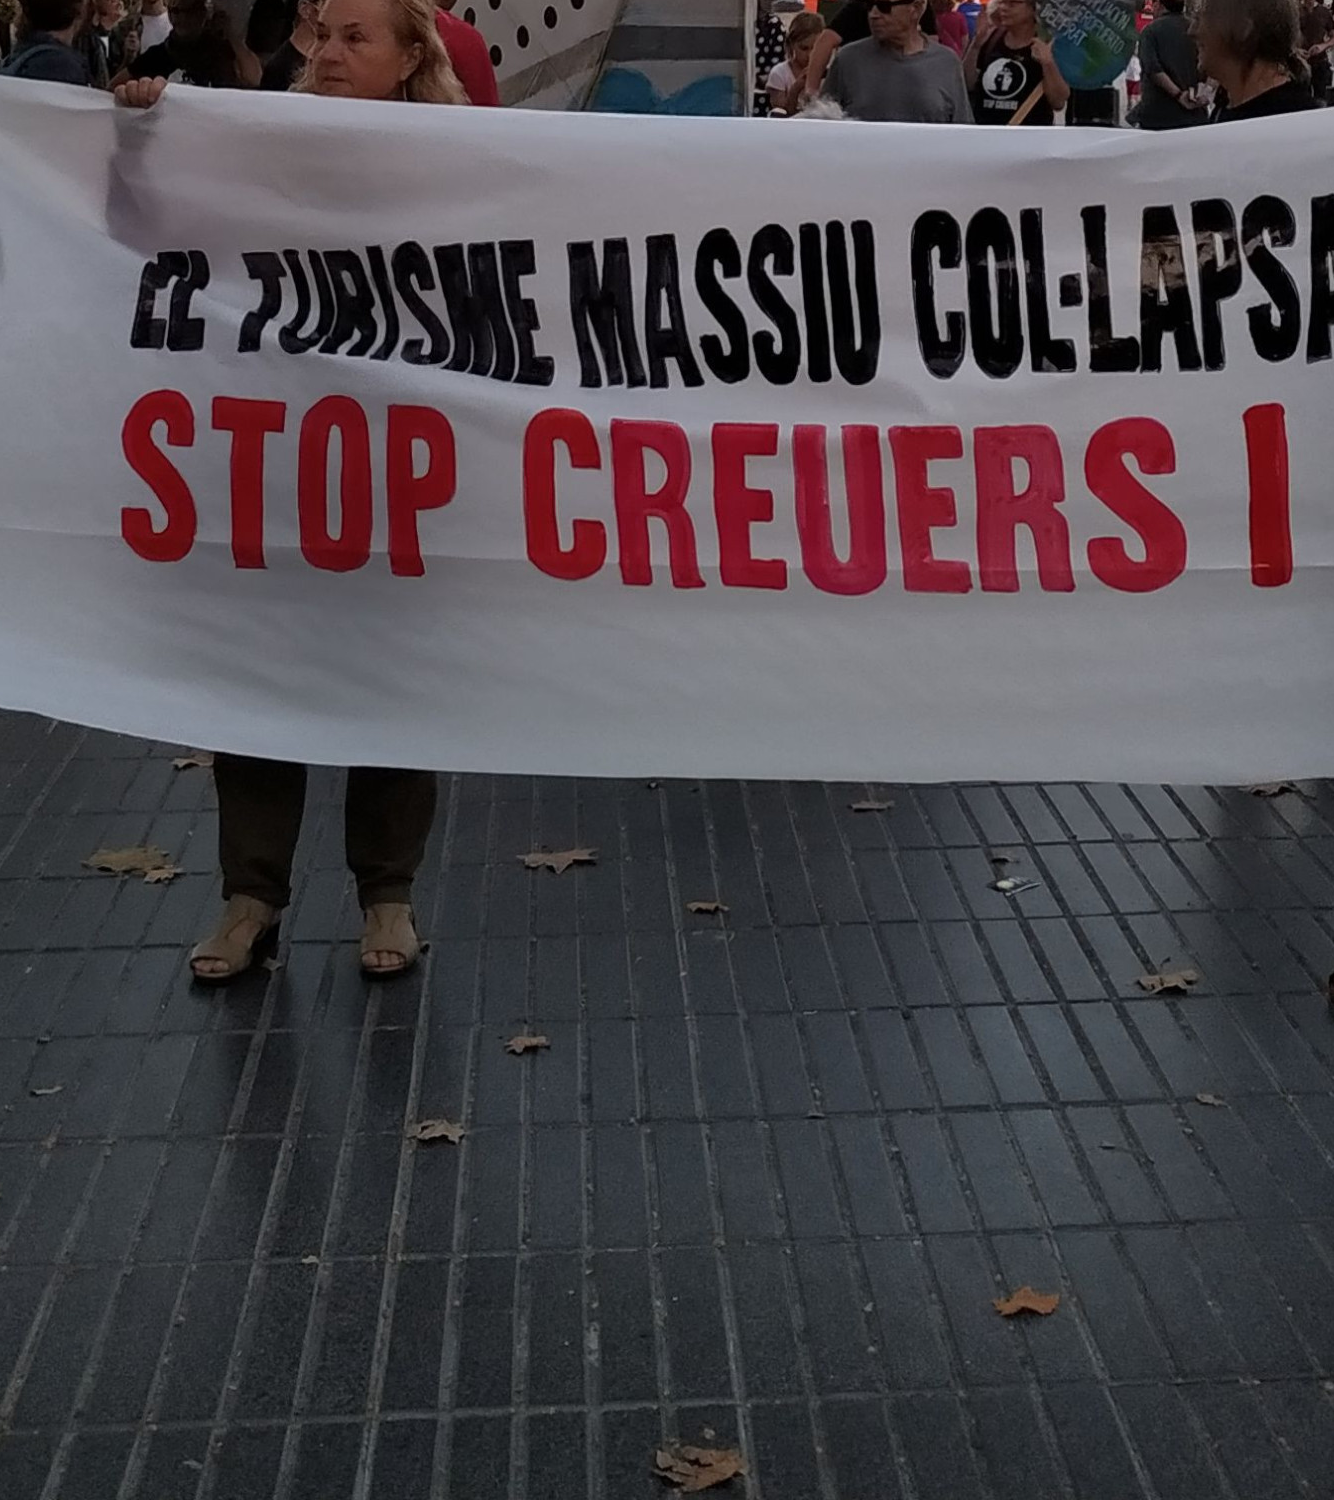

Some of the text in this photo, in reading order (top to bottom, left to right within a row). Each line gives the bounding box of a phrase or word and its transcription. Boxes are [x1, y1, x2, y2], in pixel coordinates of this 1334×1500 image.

[237, 239, 554, 386] TURISME
[566, 222, 880, 389] MASSIU
[122, 389, 456, 576] STOP
[523, 407, 1187, 595] CREUERS
[1243, 403, 1292, 587] I
